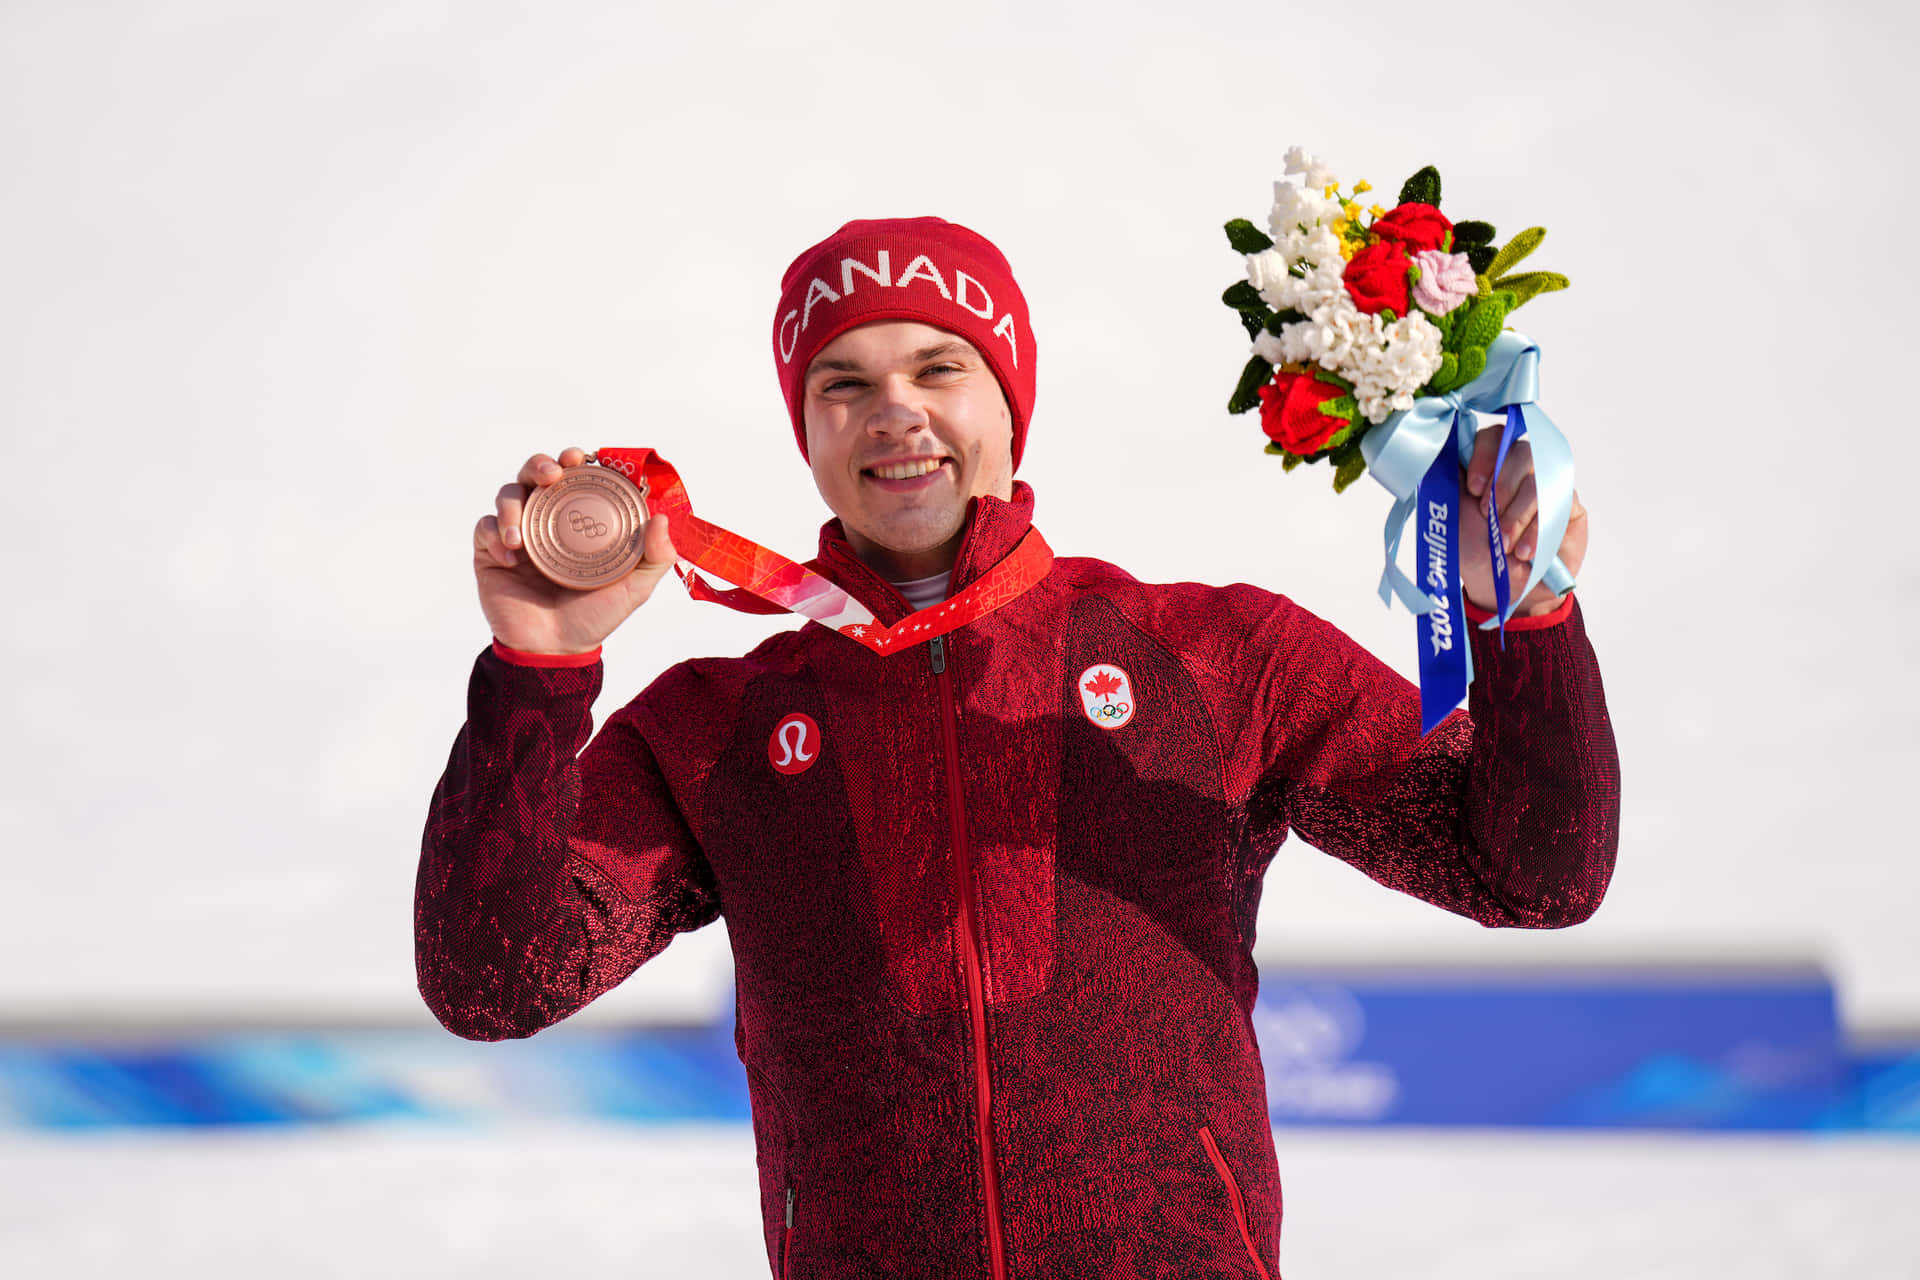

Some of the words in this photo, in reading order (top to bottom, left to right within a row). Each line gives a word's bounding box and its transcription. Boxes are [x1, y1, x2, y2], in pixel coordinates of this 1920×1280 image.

[779, 249, 1018, 370] CANADA
[1423, 500, 1448, 589] BEIJING
[1429, 593, 1453, 657] 2022
